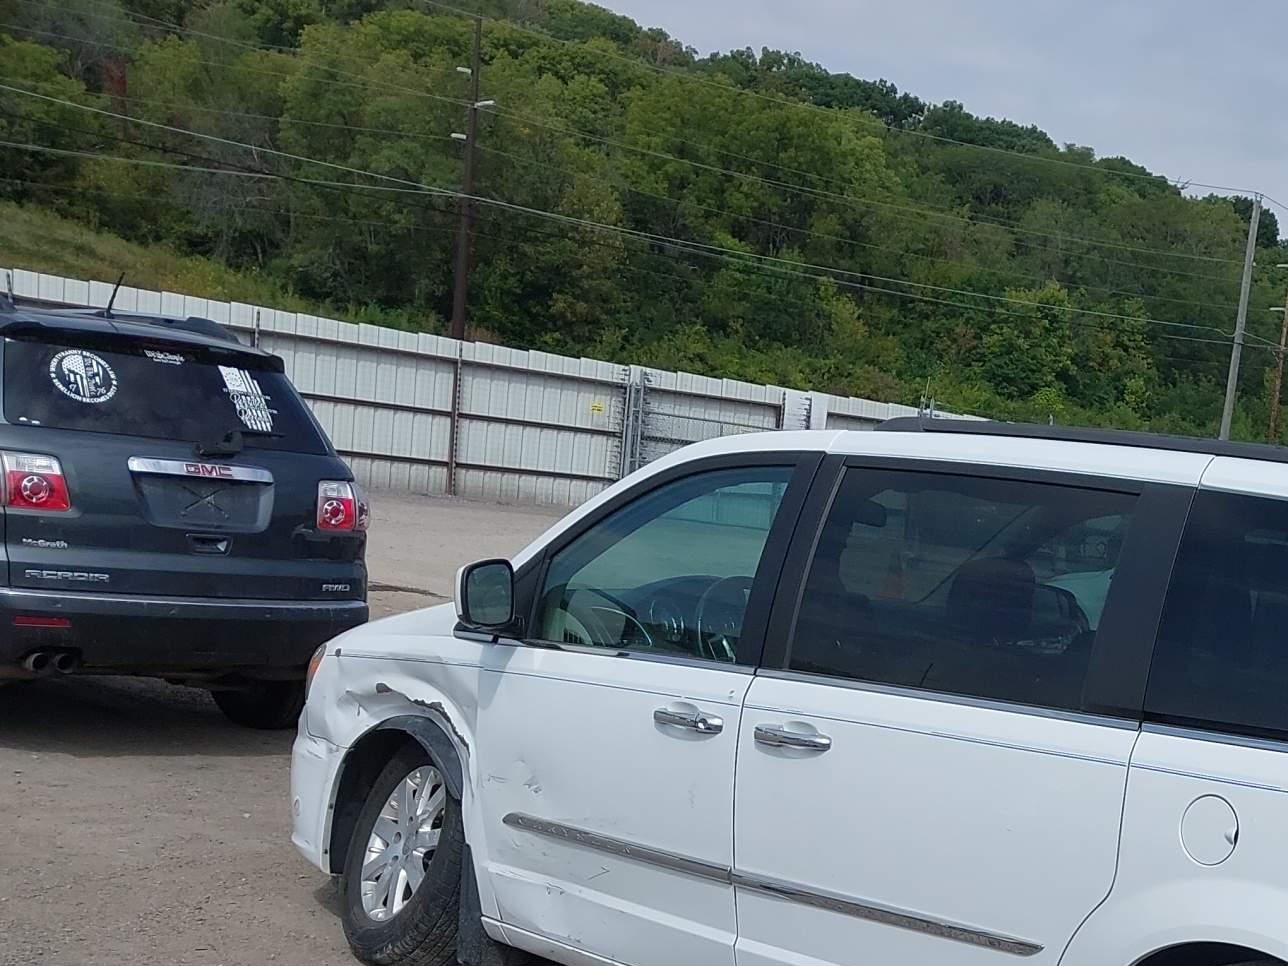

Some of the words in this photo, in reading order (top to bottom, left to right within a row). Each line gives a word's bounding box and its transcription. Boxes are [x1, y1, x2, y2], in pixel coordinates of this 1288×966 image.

[184, 463, 233, 477] GMC
[25, 569, 110, 583] ACADIA
[322, 583, 351, 592] AWD
